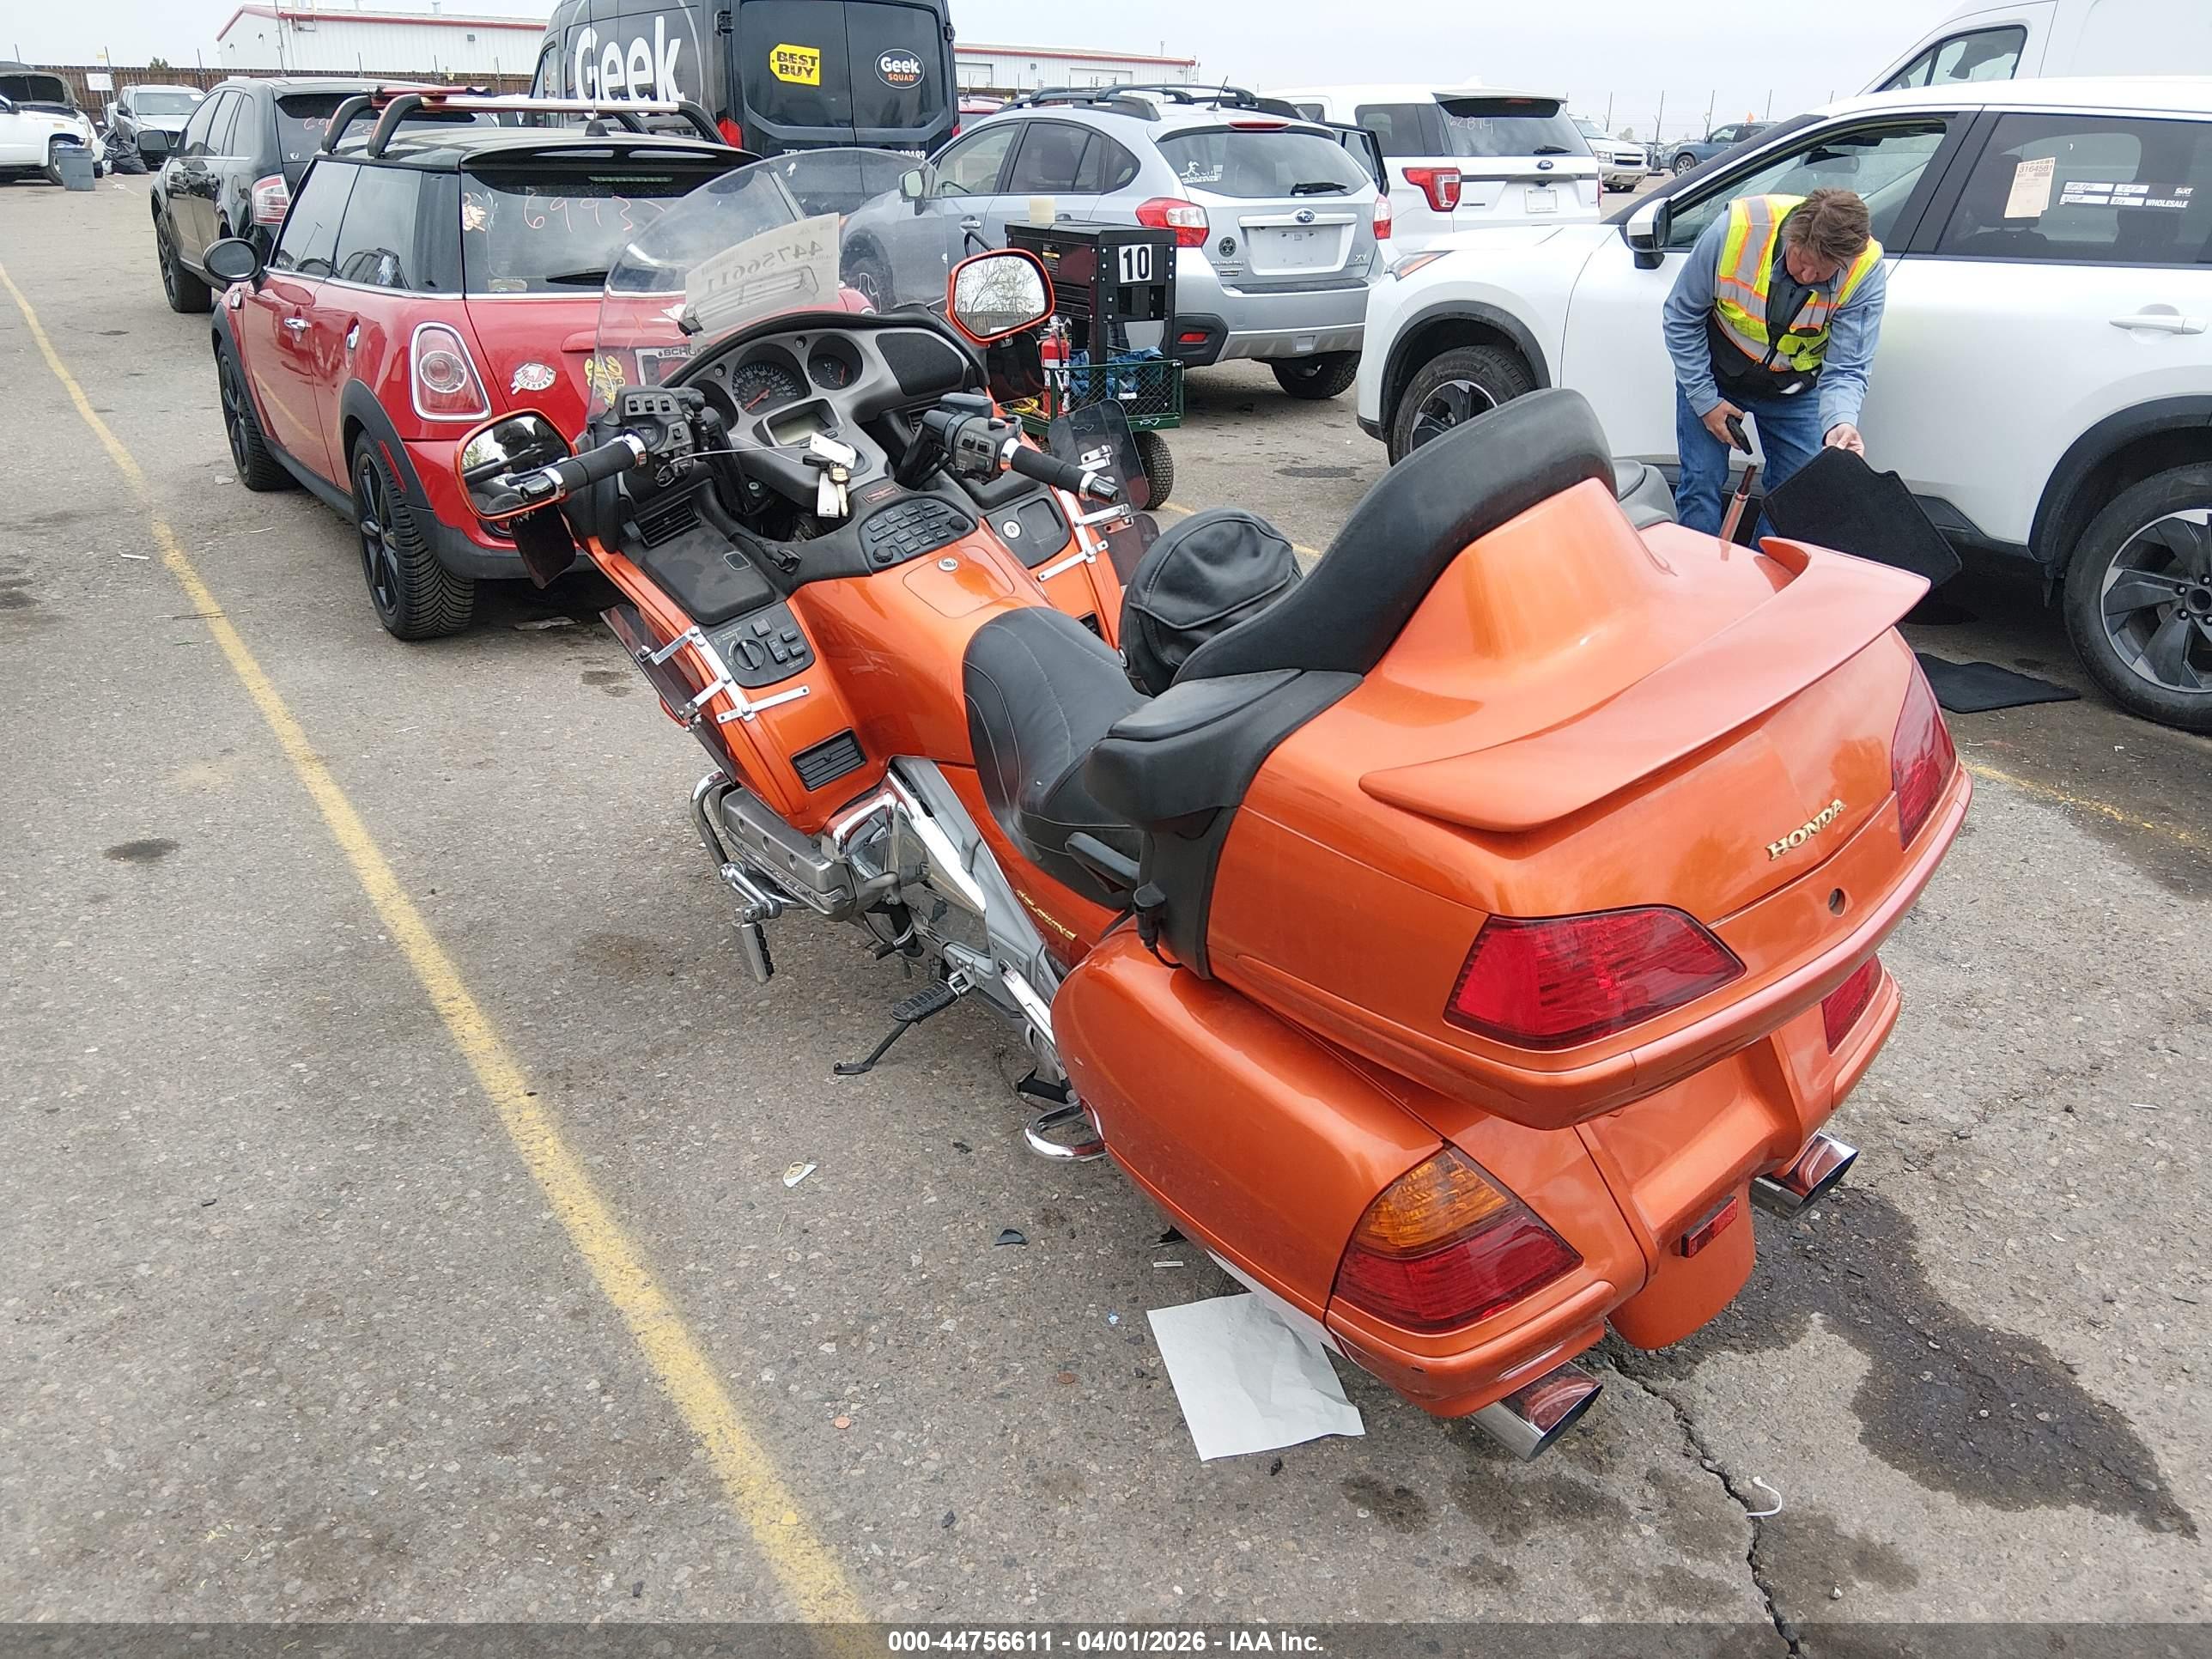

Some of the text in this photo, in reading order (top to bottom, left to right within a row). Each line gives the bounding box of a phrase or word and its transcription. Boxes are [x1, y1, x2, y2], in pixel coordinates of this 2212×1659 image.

[575, 15, 686, 118] Geek
[776, 51, 818, 67] BEST
[880, 56, 921, 75] Geek
[779, 64, 815, 79] BUY
[888, 73, 915, 82] SQUAD
[2145, 198, 2189, 208] WHOLESALE
[1122, 246, 1150, 281] 10
[1765, 799, 1847, 861] HONDA
